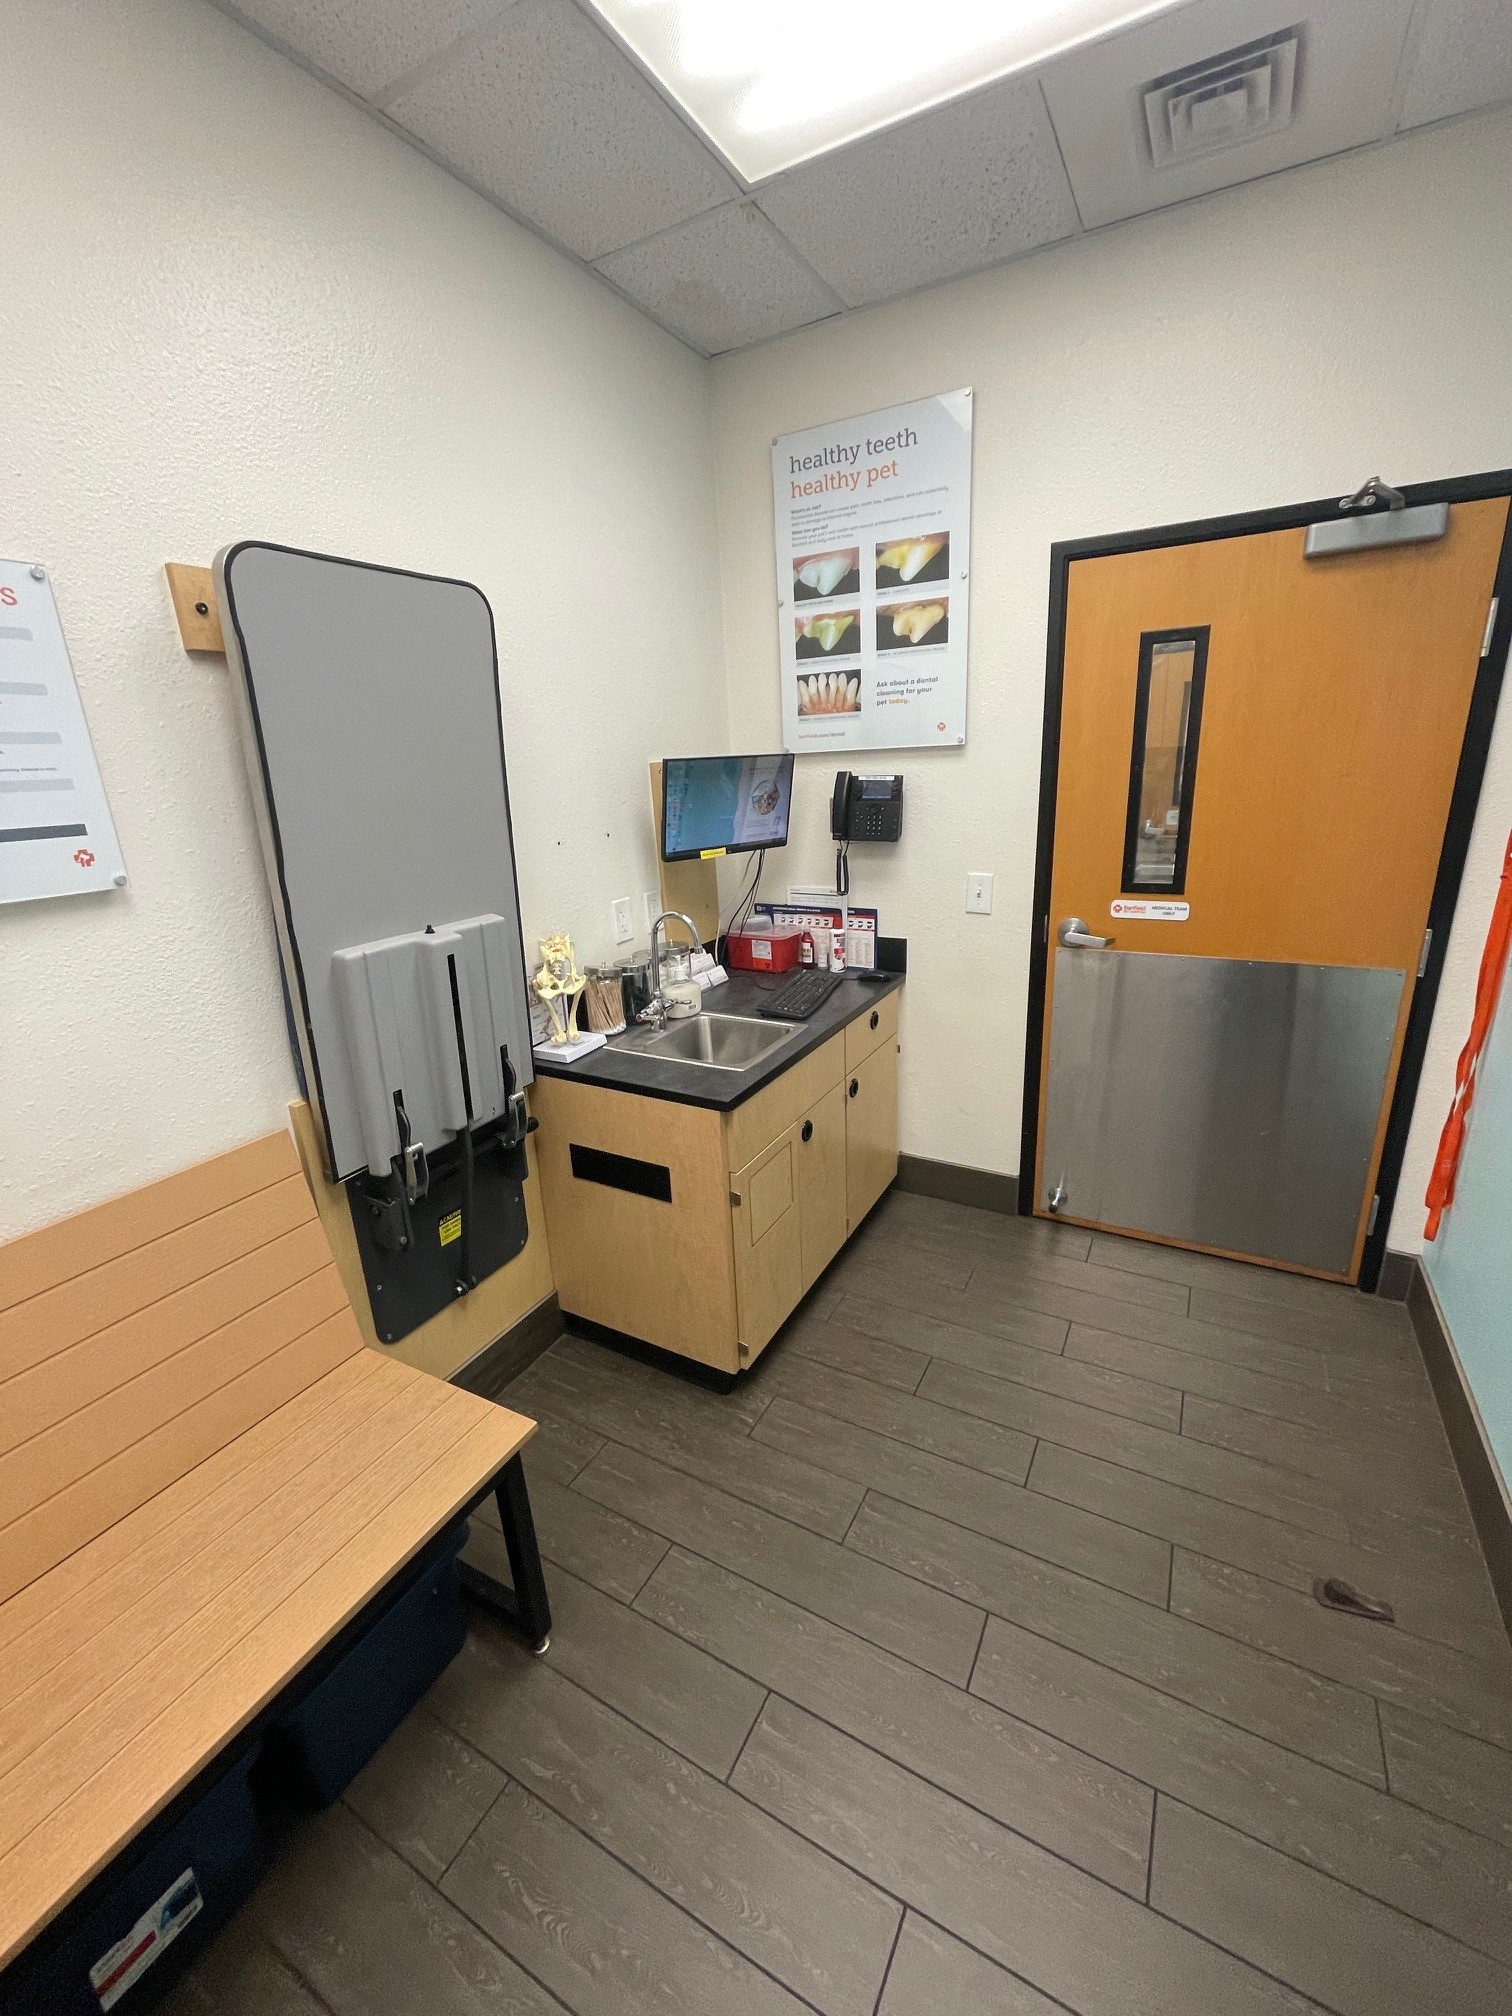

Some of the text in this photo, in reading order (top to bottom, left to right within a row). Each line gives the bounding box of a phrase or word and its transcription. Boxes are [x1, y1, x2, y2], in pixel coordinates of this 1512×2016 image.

[790, 428, 918, 473] healthy teeth
[790, 460, 899, 499] healthy pet
